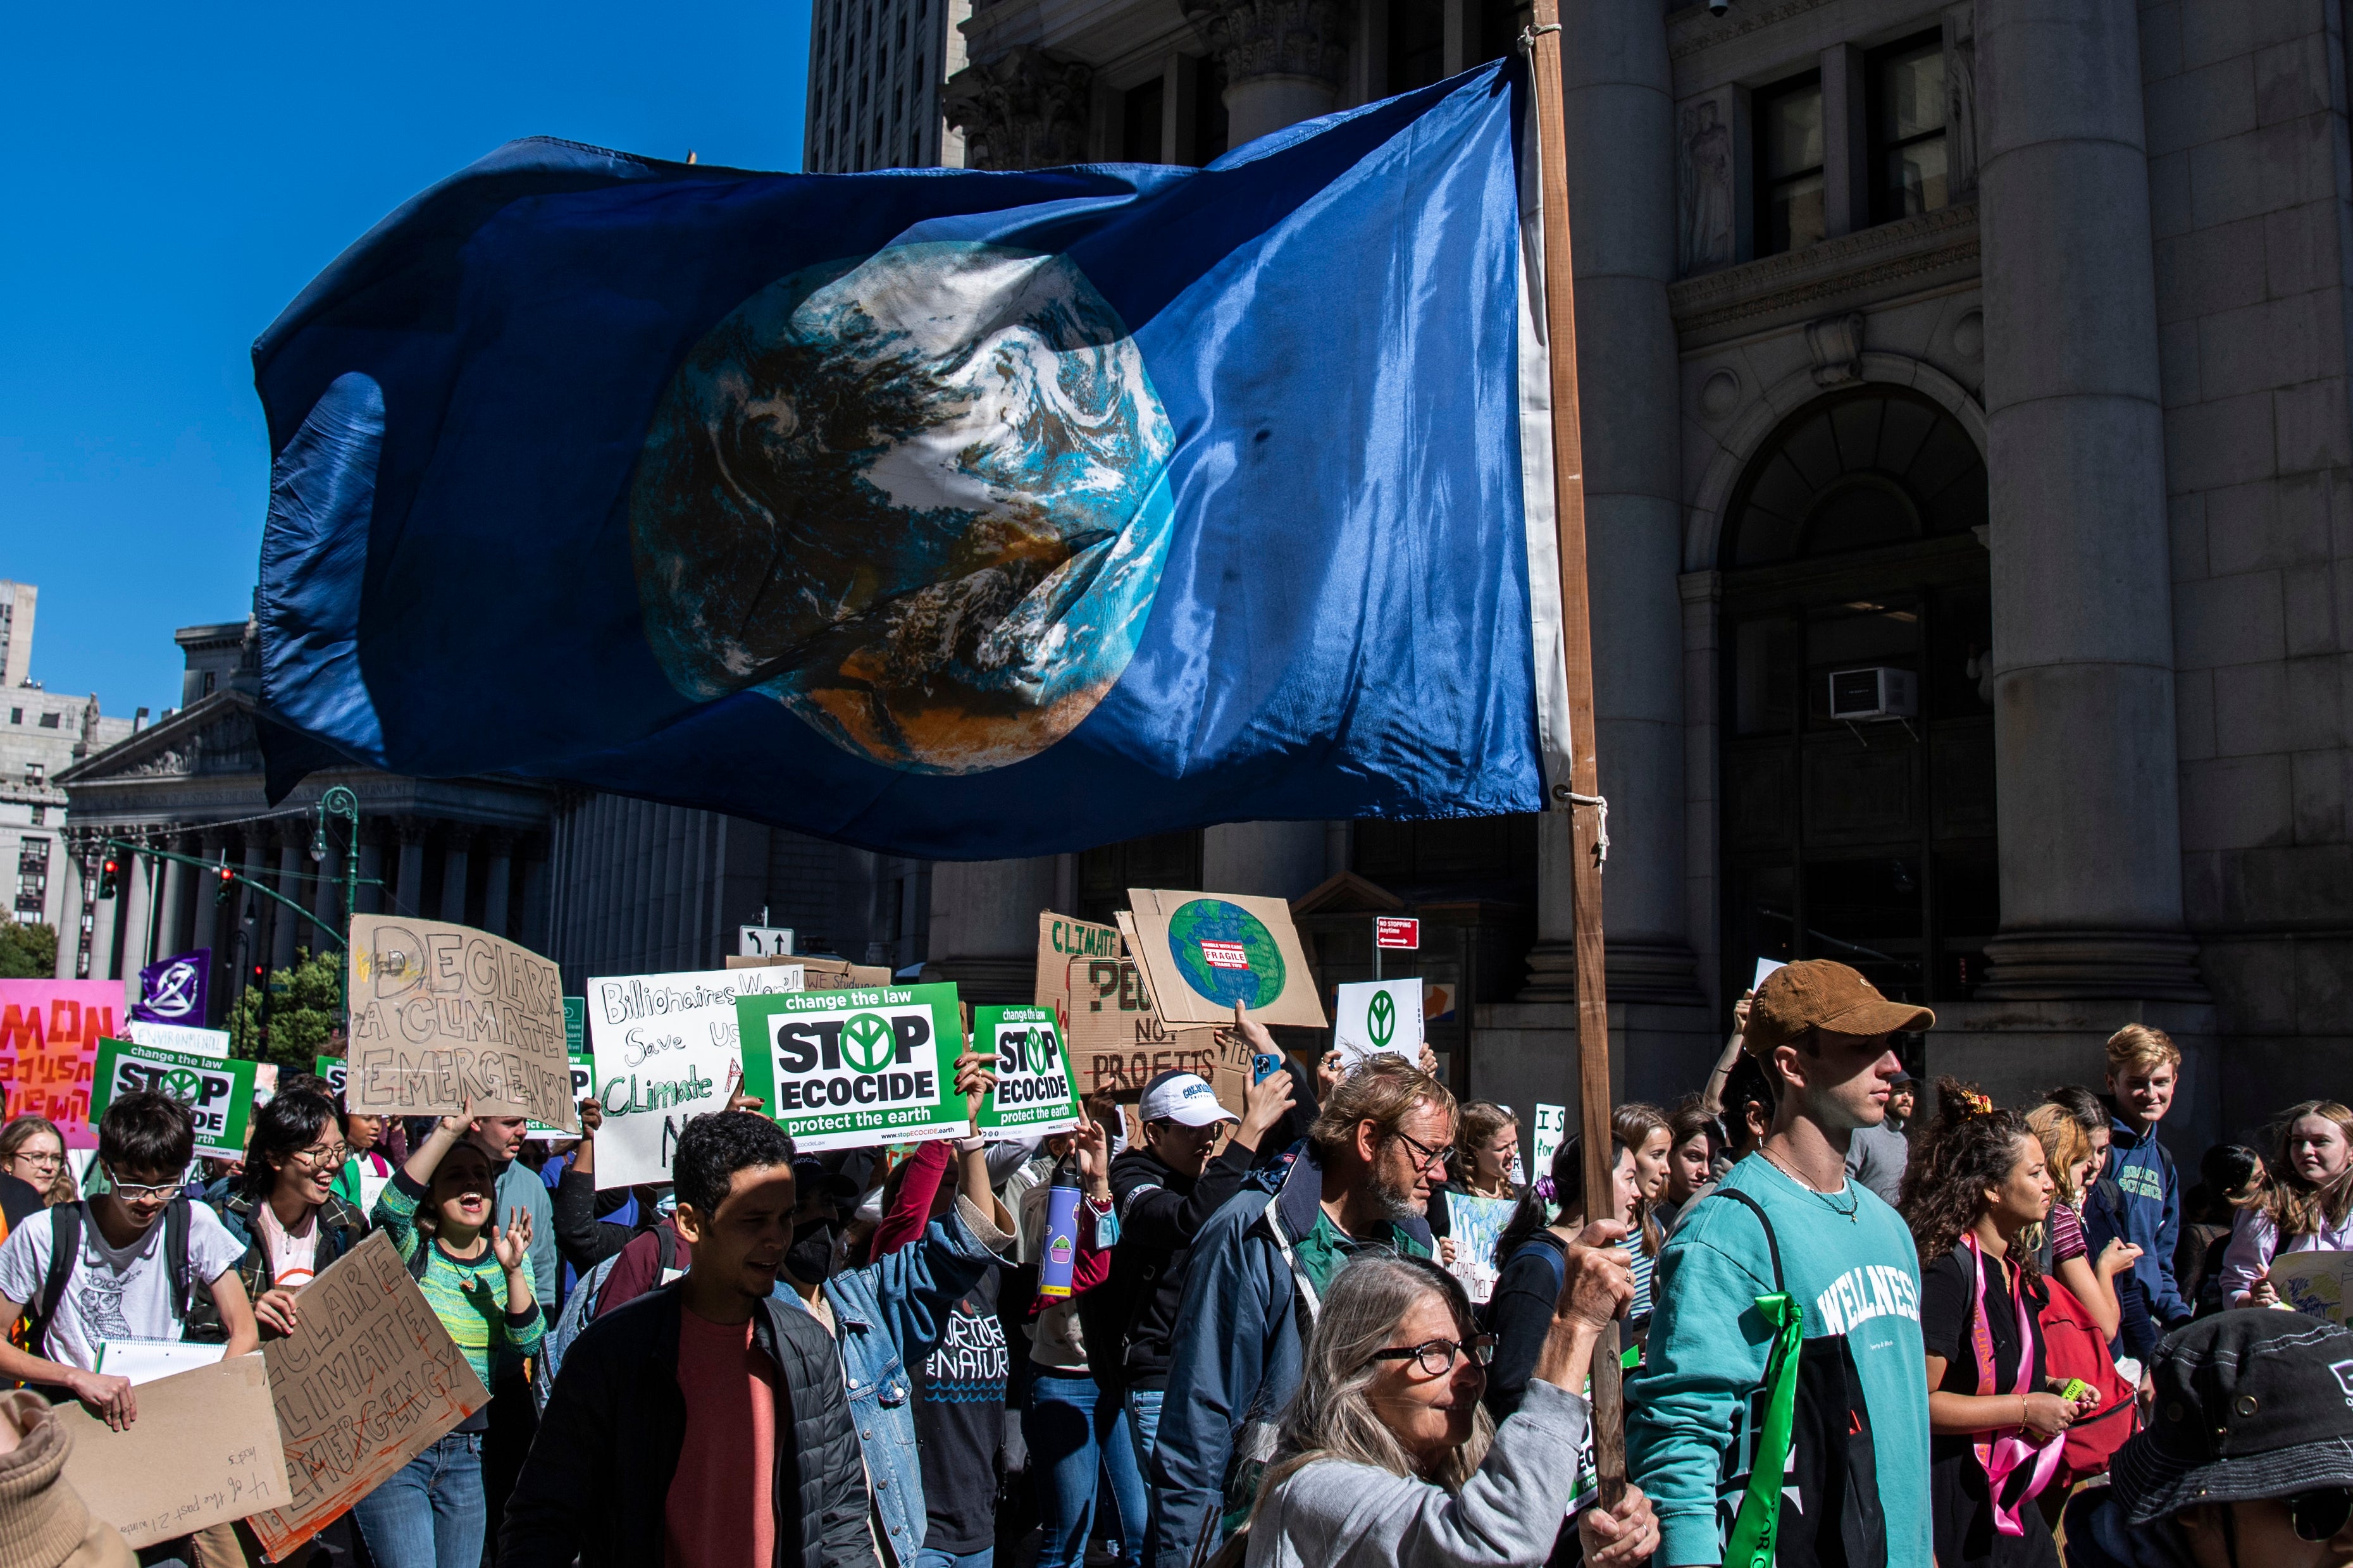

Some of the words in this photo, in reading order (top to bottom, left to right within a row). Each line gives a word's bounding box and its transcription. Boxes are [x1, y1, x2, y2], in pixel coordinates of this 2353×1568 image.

[1052, 920, 1116, 956] CLIMATE
[1205, 951, 1245, 961] FRAGILE
[373, 926, 562, 1015] DECLARE
[806, 974, 828, 990] WE
[1089, 959, 1152, 1012] PEO
[602, 979, 736, 1025] Billionaires
[785, 994, 848, 1011] change
[851, 991, 879, 1006] the
[884, 989, 912, 1004] law
[357, 1001, 388, 1040] A
[400, 997, 561, 1059] CLIMATE
[1002, 1009, 1027, 1022] change
[1027, 1009, 1036, 1021] the
[1036, 1009, 1046, 1020] law
[138, 1027, 222, 1051] ENVIRONMENTAL
[624, 1027, 686, 1068] Save
[777, 1013, 931, 1075] STOP
[999, 1026, 1057, 1076] STOP
[0, 1054, 93, 1084] USTICE
[130, 1046, 175, 1063] change
[178, 1054, 199, 1066] the
[201, 1058, 223, 1070] law
[1093, 1047, 1215, 1092] PROFITS
[363, 1047, 569, 1125] EMERGENCY
[781, 1070, 934, 1111] ECOCIDE
[998, 1075, 1067, 1105] ECOCIDE
[788, 1114, 852, 1136] protect
[855, 1111, 883, 1127] the
[888, 1106, 931, 1124] earth
[1000, 1109, 1034, 1126] protect
[1036, 1106, 1050, 1120] the
[1050, 1103, 1069, 1117] earth
[1537, 1110, 1549, 1130] I
[793, 1140, 826, 1149] EcocideLaw
[881, 1127, 955, 1139] www.stopECOCIDE.earth
[1537, 1138, 1555, 1157] for
[274, 1295, 434, 1440] LIMATE
[2068, 1383, 2078, 1396] OUT
[282, 1342, 463, 1513] EMERGENCY
[227, 1476, 242, 1503] of
[248, 1472, 270, 1500] 4
[174, 1495, 201, 1521] past
[204, 1491, 225, 1510] the
[151, 1512, 170, 1532] 21
